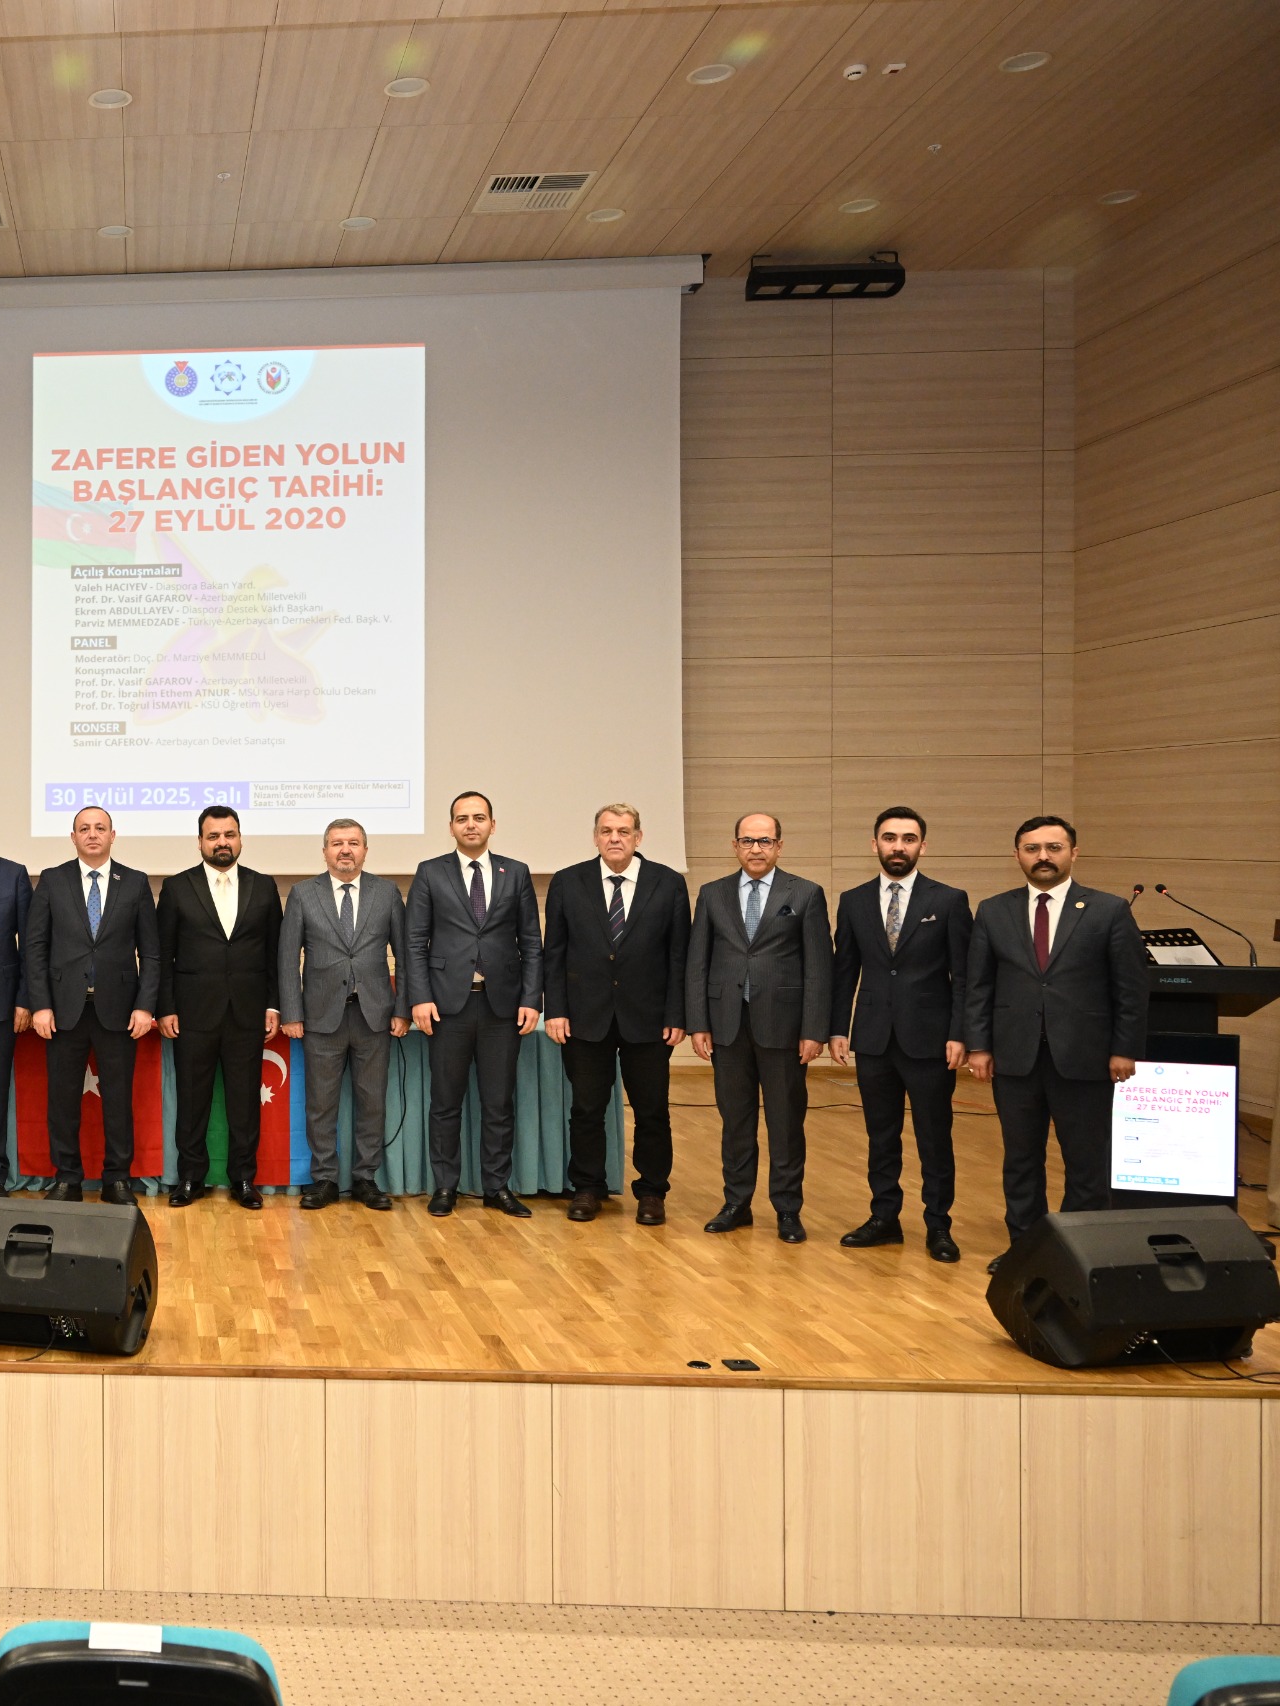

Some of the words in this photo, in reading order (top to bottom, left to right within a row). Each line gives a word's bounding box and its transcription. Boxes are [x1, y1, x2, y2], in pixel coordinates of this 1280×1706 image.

[51, 447, 176, 470] ZAFERE
[186, 440, 284, 469] GİDEN
[296, 442, 405, 465] YOLUN
[73, 475, 258, 505] BAŞLANGIÇ
[268, 469, 383, 498] TARİHİ:
[109, 510, 144, 533] 27
[155, 503, 255, 532] EYLÜL
[266, 506, 346, 530] 2020
[74, 568, 104, 579] Açılış
[108, 566, 179, 578] Konuşmaları
[106, 583, 147, 591] HACIYEV
[156, 582, 197, 591] Diaspora
[201, 582, 228, 590] Bakan
[231, 582, 255, 590] Yard.
[75, 595, 98, 603] Prof.
[118, 595, 142, 603] Vasif
[146, 594, 192, 602] GAFAROV
[200, 593, 254, 604] Azerbaycan
[257, 592, 306, 601] Milletvekili
[75, 607, 106, 615] Ekrem
[109, 607, 173, 615] ABDULLAYEV
[182, 605, 223, 615] Diaspora
[227, 605, 258, 613] Destek
[75, 619, 104, 627] Parviz
[108, 618, 180, 627] MEMMEDZADE
[282, 615, 331, 625] Dernekleri
[334, 615, 353, 624] Fed.
[357, 615, 380, 625] Başk.
[384, 615, 392, 623] V.
[74, 638, 111, 647] PANEL
[75, 654, 130, 663] Moderatör:
[134, 654, 153, 664] Doç.
[157, 654, 170, 662] Dr.
[173, 653, 209, 663] Marziye
[75, 666, 145, 675] Konuşmacılar:
[75, 678, 97, 686] Prof.
[118, 677, 142, 686] Vasif
[146, 677, 192, 685] GAFAROV
[200, 677, 254, 687] Azerbaycan
[257, 676, 306, 685] Milletvekili
[75, 690, 97, 699] Prof.
[118, 688, 157, 698] İbrahim
[161, 689, 192, 697] Ethem
[195, 689, 229, 697] ATNUR
[263, 688, 284, 696] Kara
[287, 688, 309, 698] Harp
[313, 687, 340, 696] Okulu
[75, 702, 97, 710] Prof.
[119, 701, 149, 712] Toğrul
[73, 723, 120, 733] KONSER
[73, 738, 102, 747] Samir
[156, 738, 209, 748] Azerbaycan
[213, 737, 241, 746] Devlet
[303, 783, 331, 791] Kongre
[51, 788, 76, 806] 30
[83, 787, 133, 807] Eylül
[141, 787, 195, 807] 2025,
[203, 787, 240, 804] Salı
[1119, 1086, 1157, 1094] ZAFERE
